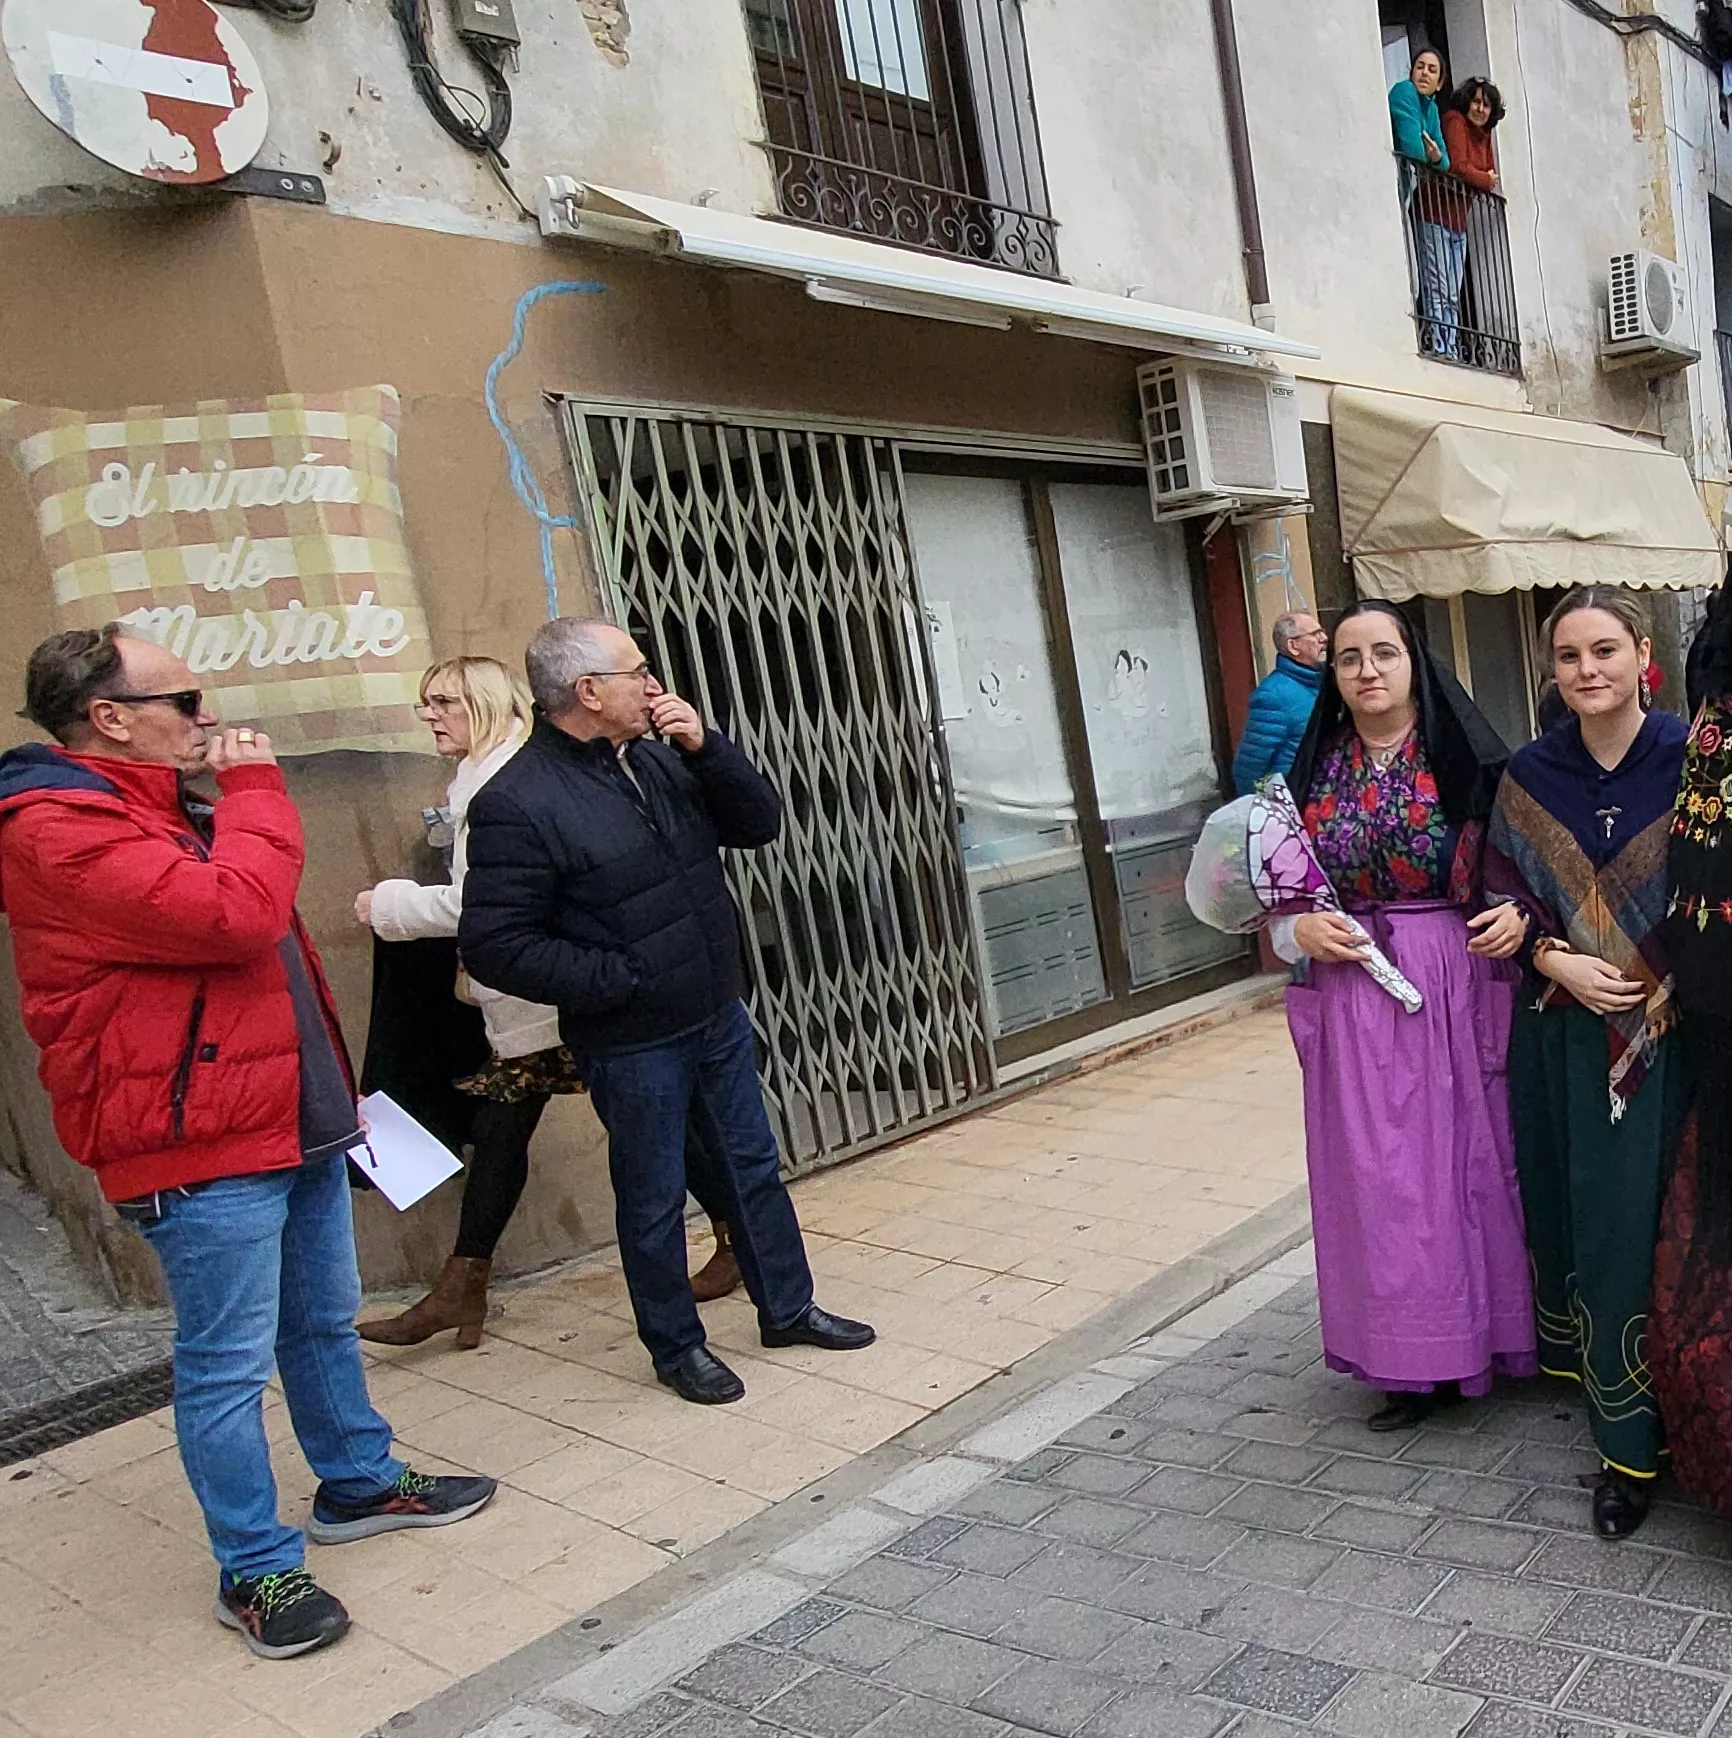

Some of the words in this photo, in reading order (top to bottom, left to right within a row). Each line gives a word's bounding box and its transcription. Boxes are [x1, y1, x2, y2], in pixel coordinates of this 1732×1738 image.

[85, 462, 158, 528] El
[166, 452, 360, 513] rincón
[203, 535, 272, 592] de
[120, 590, 412, 674] Mariate
